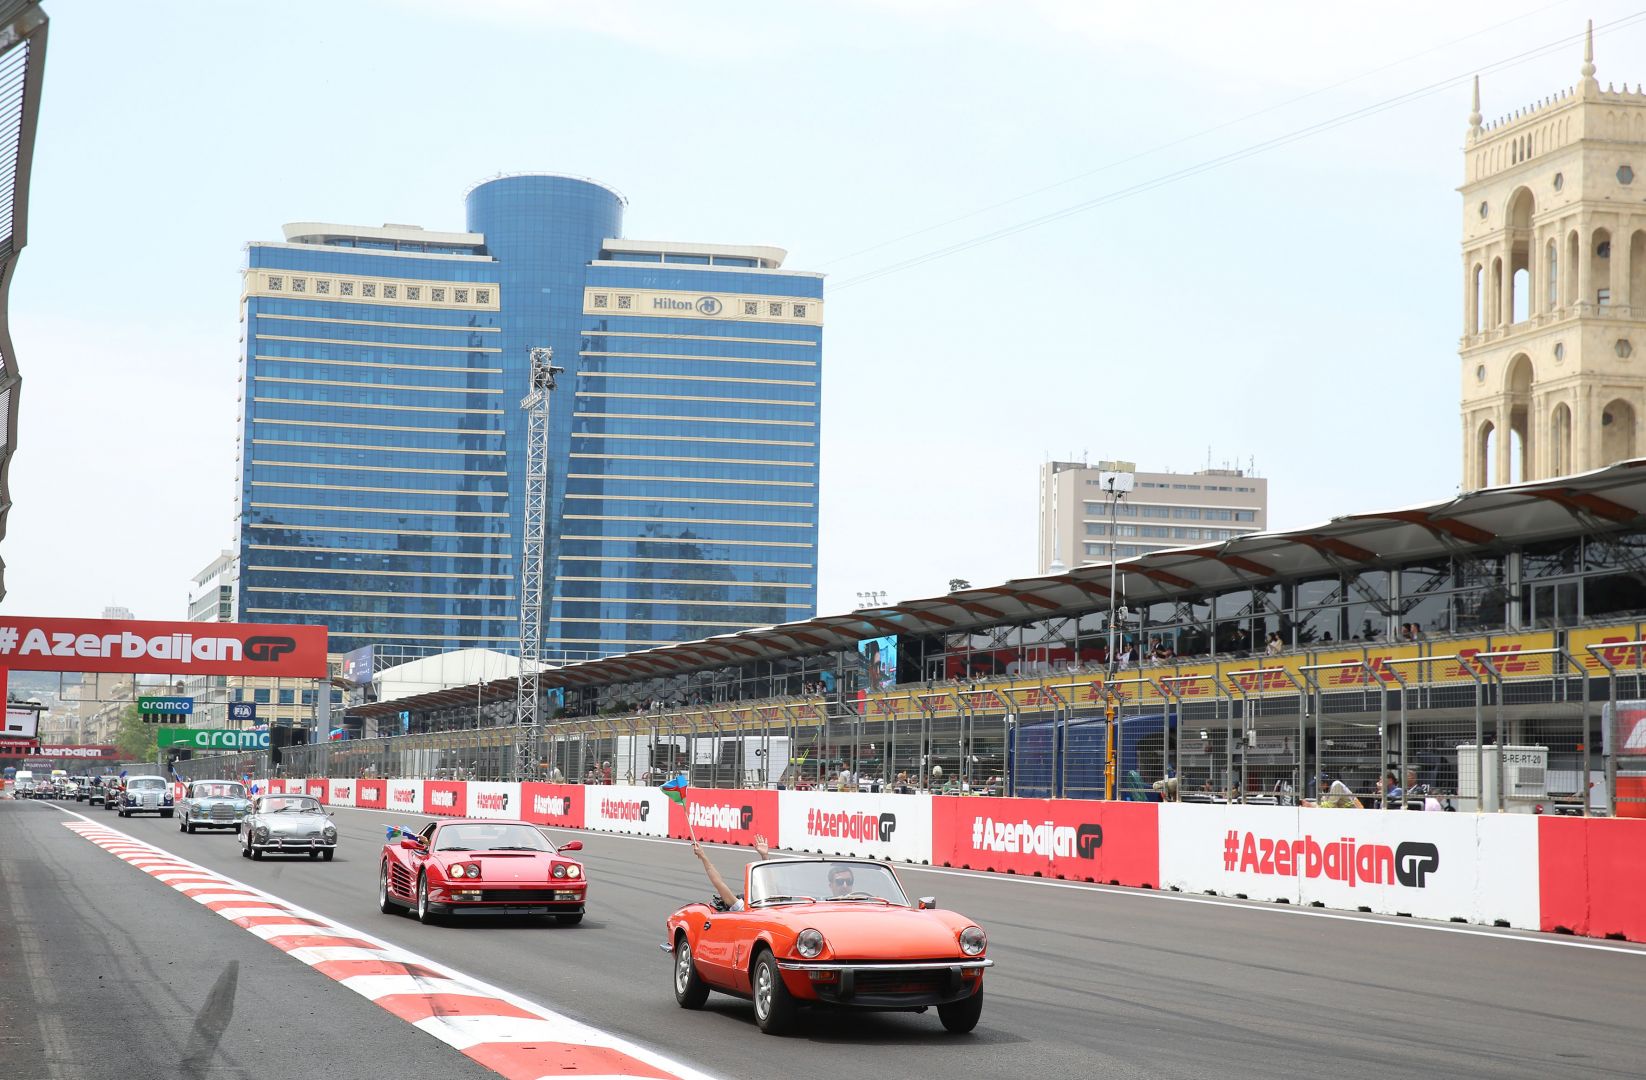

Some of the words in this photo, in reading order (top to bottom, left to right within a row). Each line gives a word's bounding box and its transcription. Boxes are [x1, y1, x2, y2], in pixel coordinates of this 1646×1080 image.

[653, 298, 693, 310] Hilton
[0, 626, 296, 663] #AzerbaijanGP
[142, 701, 190, 710] aramco
[234, 706, 249, 716] FIA
[195, 731, 270, 747] aramc
[601, 798, 650, 822] #AzerbaijanGP
[688, 801, 753, 832] #AzerbaijanGP
[807, 808, 897, 843] #AzerbaijanGP
[972, 816, 1103, 860] #AzerbaijanGP
[1223, 830, 1439, 888] #AzerbaijanGP
